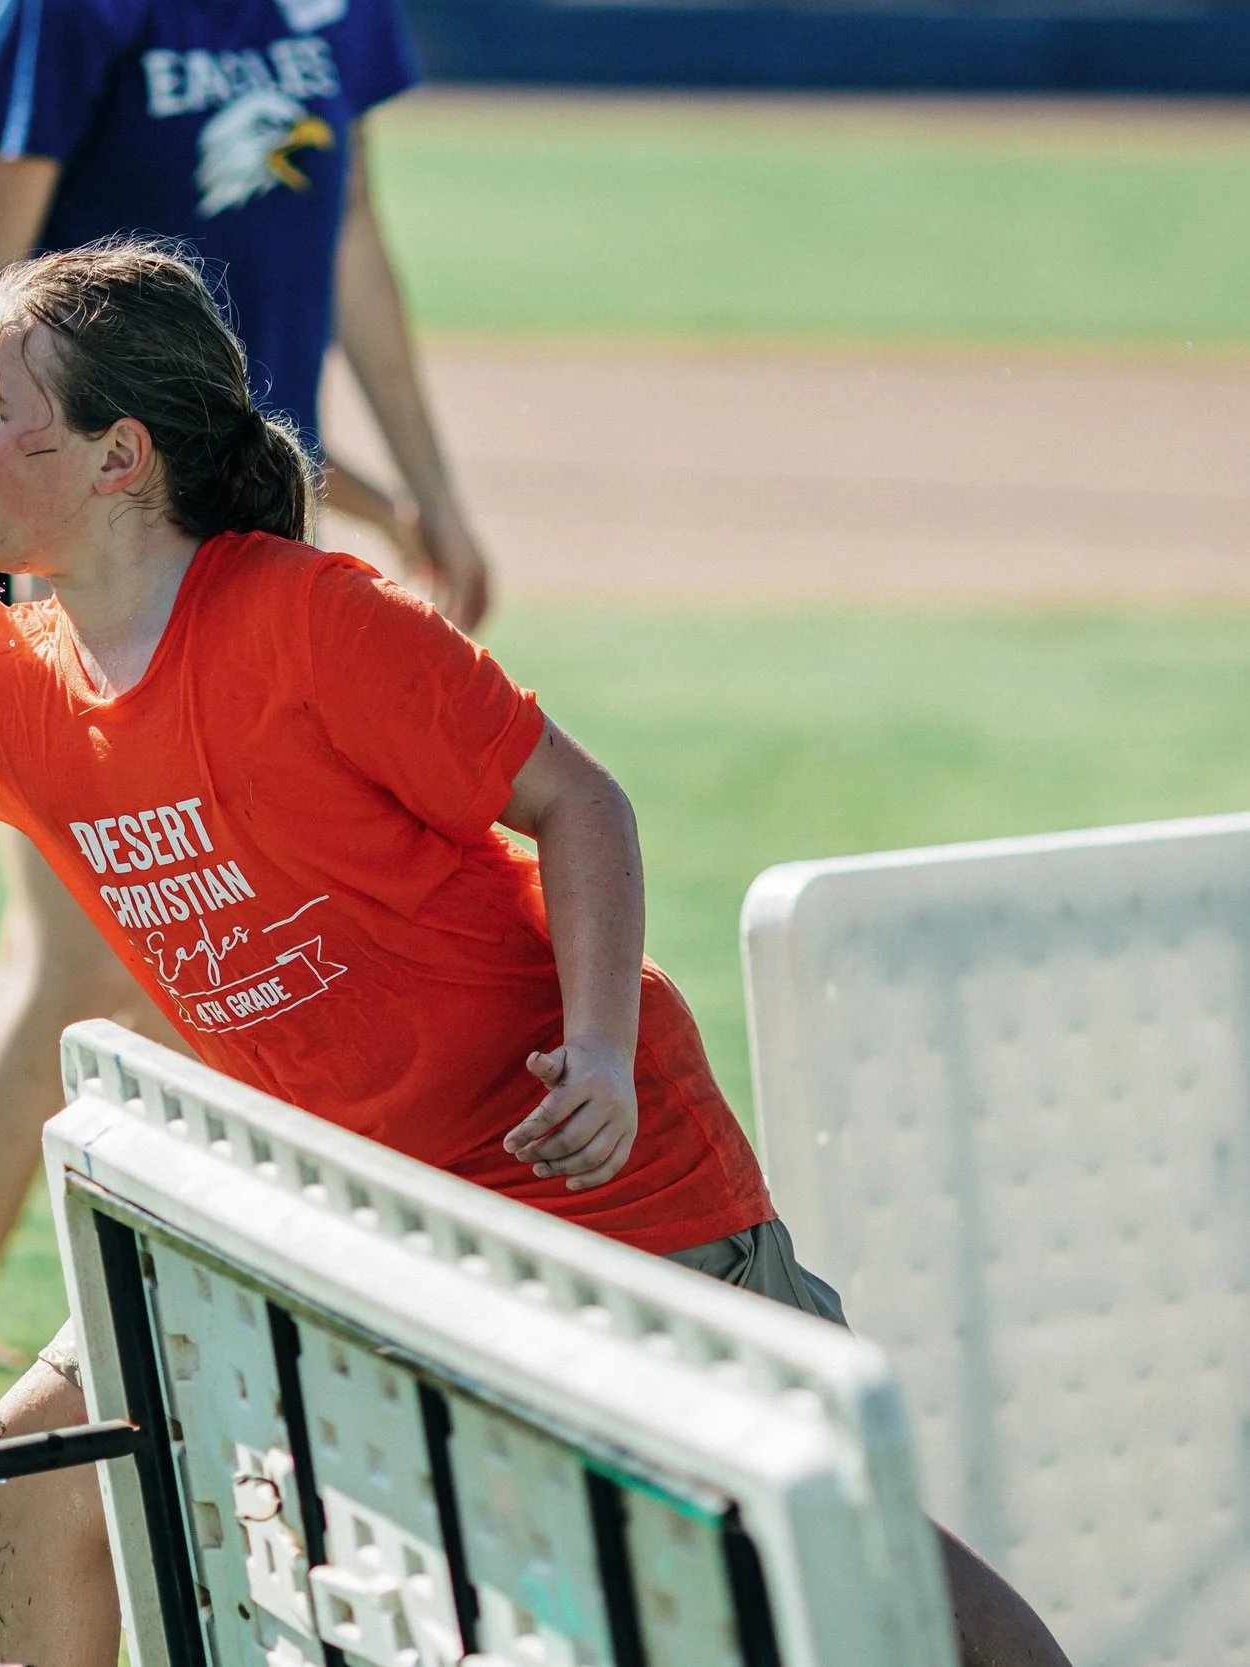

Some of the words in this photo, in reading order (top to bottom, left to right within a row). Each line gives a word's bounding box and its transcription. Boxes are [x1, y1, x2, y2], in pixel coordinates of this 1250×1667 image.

[69, 797, 214, 874] DESERT
[100, 860, 256, 928] CHRISTIAN
[146, 919, 250, 986] Eagles
[196, 1000, 231, 1026] 4TH
[226, 976, 292, 1018] GRADE
